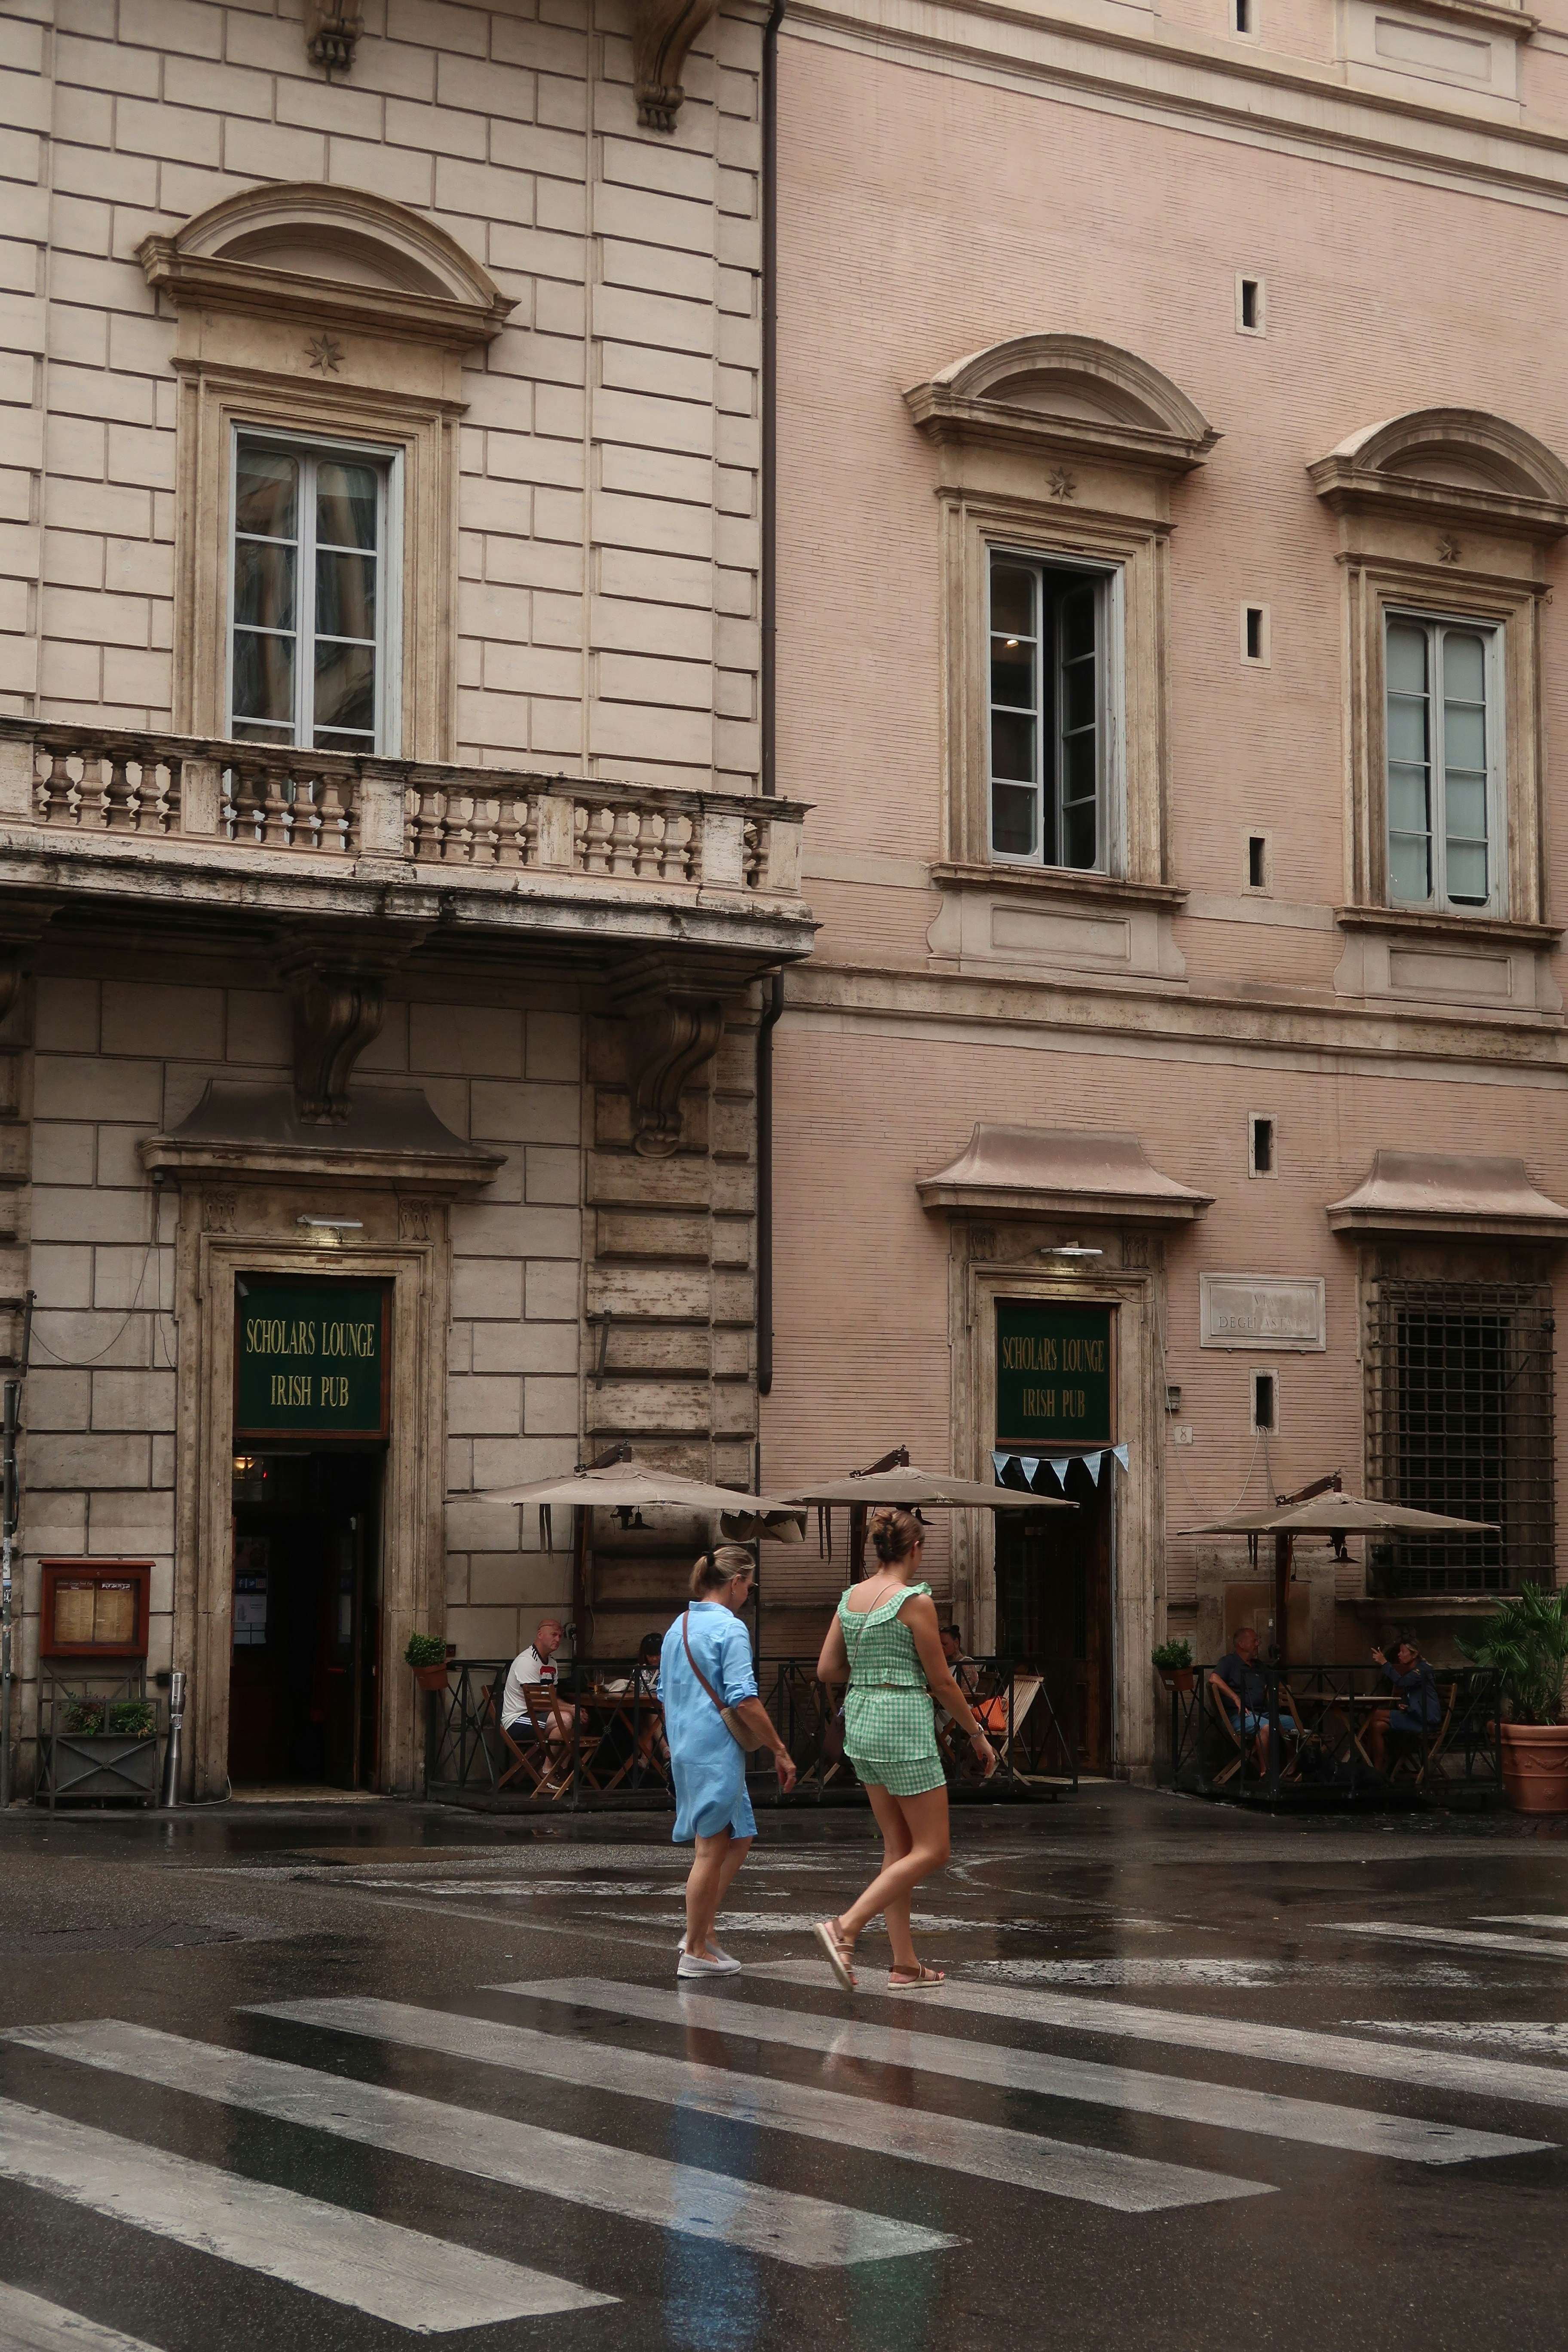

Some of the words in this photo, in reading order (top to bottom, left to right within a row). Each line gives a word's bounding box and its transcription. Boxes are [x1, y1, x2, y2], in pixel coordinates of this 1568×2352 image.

[1254, 1295, 1275, 1307] VIA
[1219, 1316, 1256, 1329] DEGLI
[246, 1319, 315, 1355] SCHOLARS
[322, 1322, 374, 1357] LOUNGE
[1003, 1336, 1057, 1371] SCHOLARS
[1063, 1338, 1105, 1372] LOUNGE
[270, 1375, 312, 1406] IRISH
[320, 1376, 349, 1407] PUB
[1023, 1389, 1055, 1417] IRISH
[1063, 1390, 1085, 1418] PUB
[1180, 1427, 1187, 1442] 8
